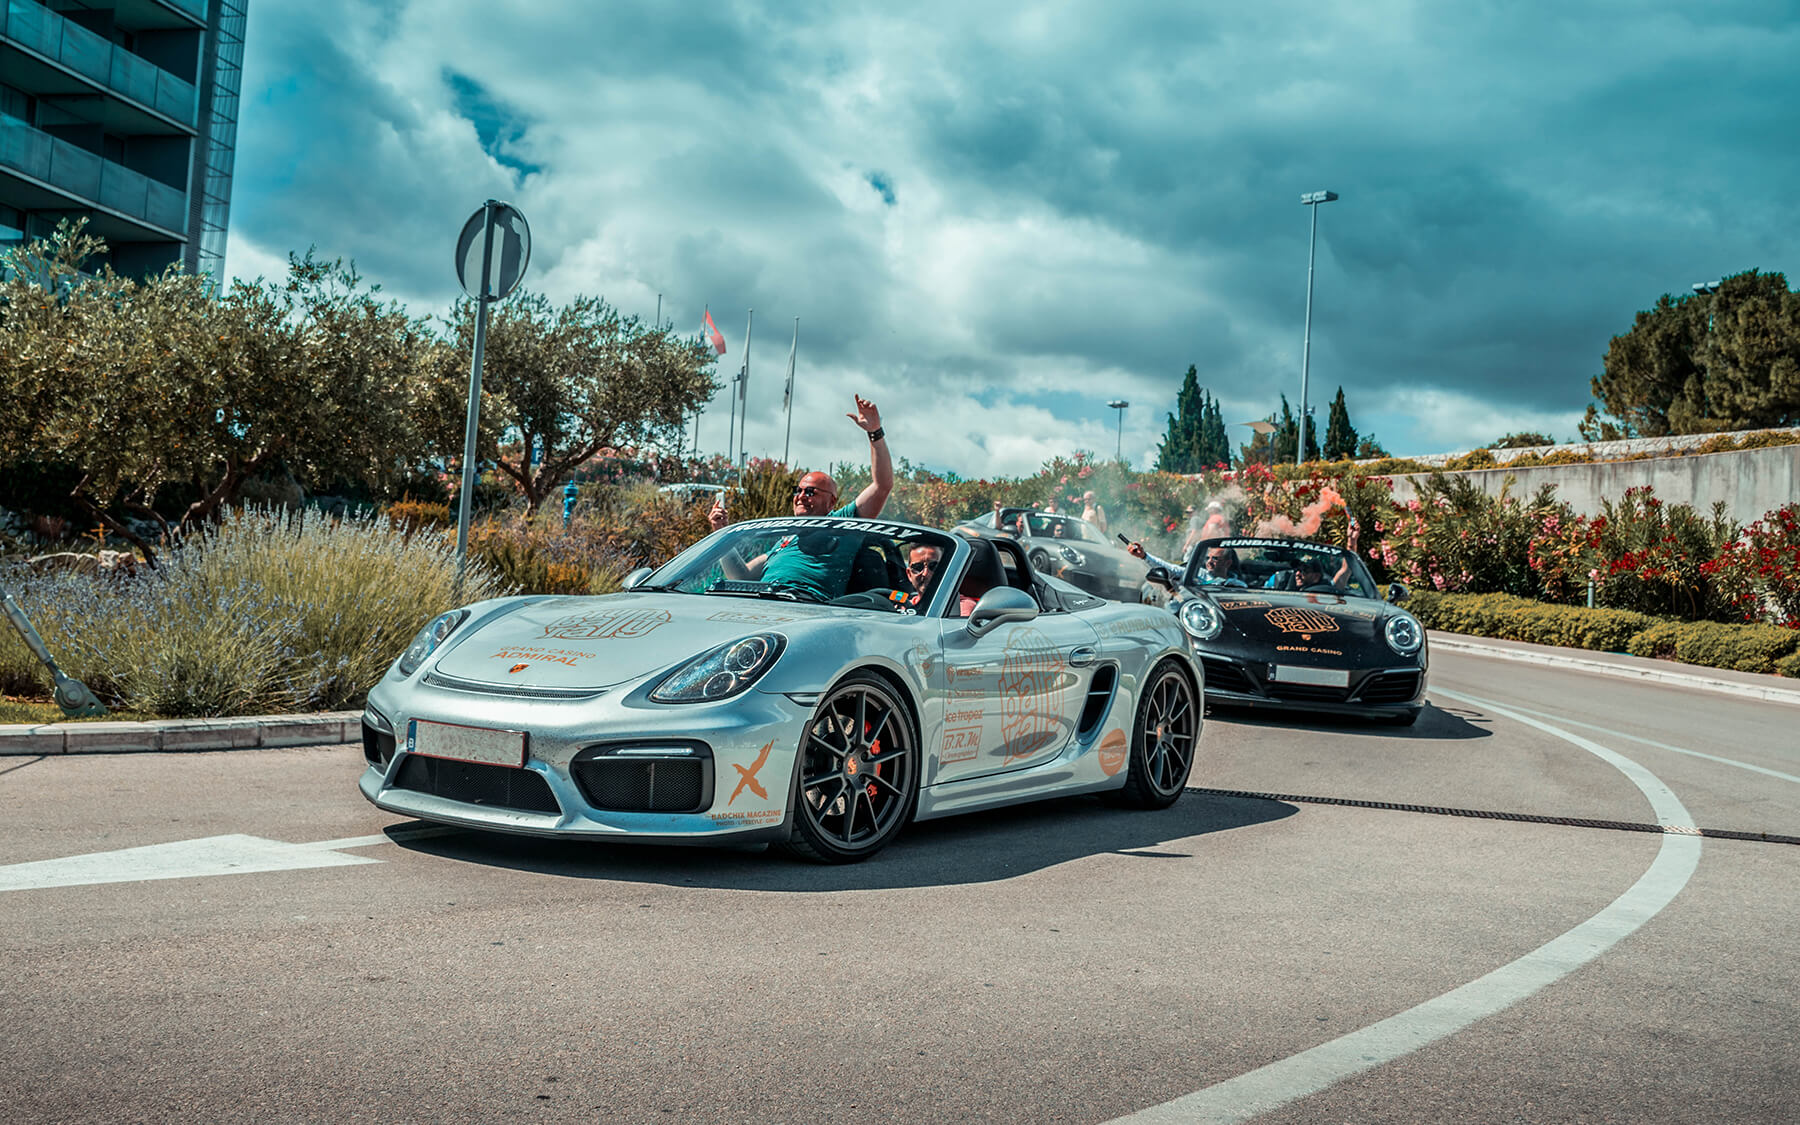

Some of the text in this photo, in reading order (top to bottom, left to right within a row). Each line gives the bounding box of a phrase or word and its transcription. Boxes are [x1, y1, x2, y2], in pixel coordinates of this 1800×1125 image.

[833, 520, 922, 538] RALLY
[1219, 539, 1342, 555] RUNBALL RALLY
[489, 651, 578, 666] ADMIRAL
[1311, 647, 1343, 656] CASINO
[746, 809, 782, 819] MAGAZINE
